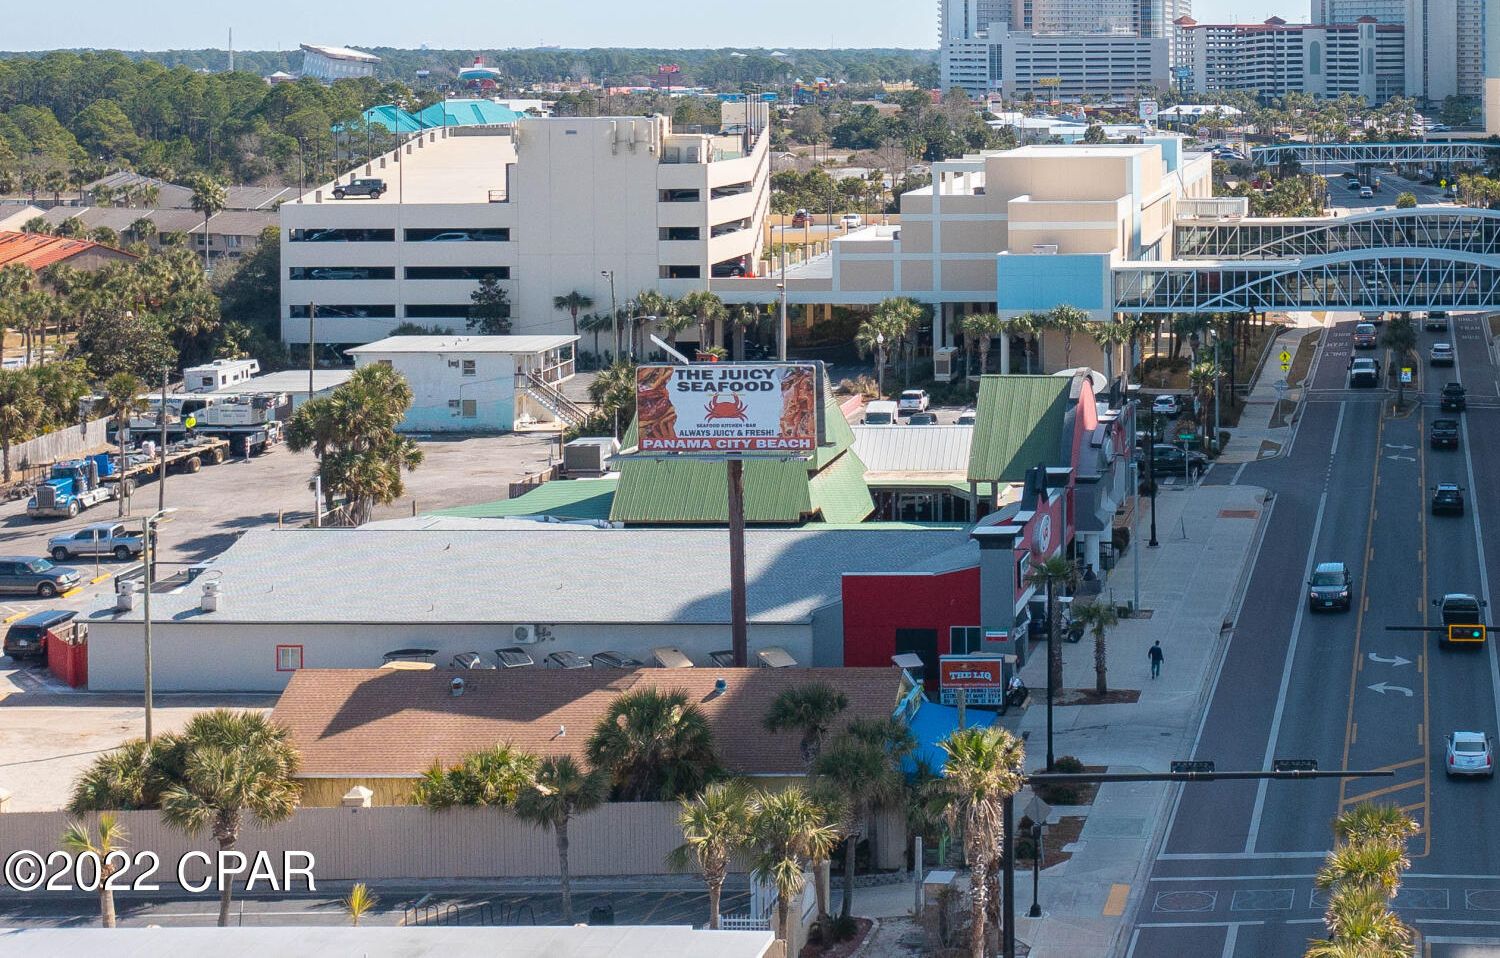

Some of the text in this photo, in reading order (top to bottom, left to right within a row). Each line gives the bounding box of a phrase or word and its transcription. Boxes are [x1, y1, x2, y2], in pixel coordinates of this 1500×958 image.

[675, 369, 775, 380] THE JUICY
[677, 381, 774, 392] SEAFOOD
[679, 429, 711, 437] ALWAYS
[713, 429, 735, 437] JUICY
[745, 429, 775, 437] FRESH!
[643, 438, 811, 449] PANAMA CITY BEACH
[973, 672, 992, 681] LIQ
